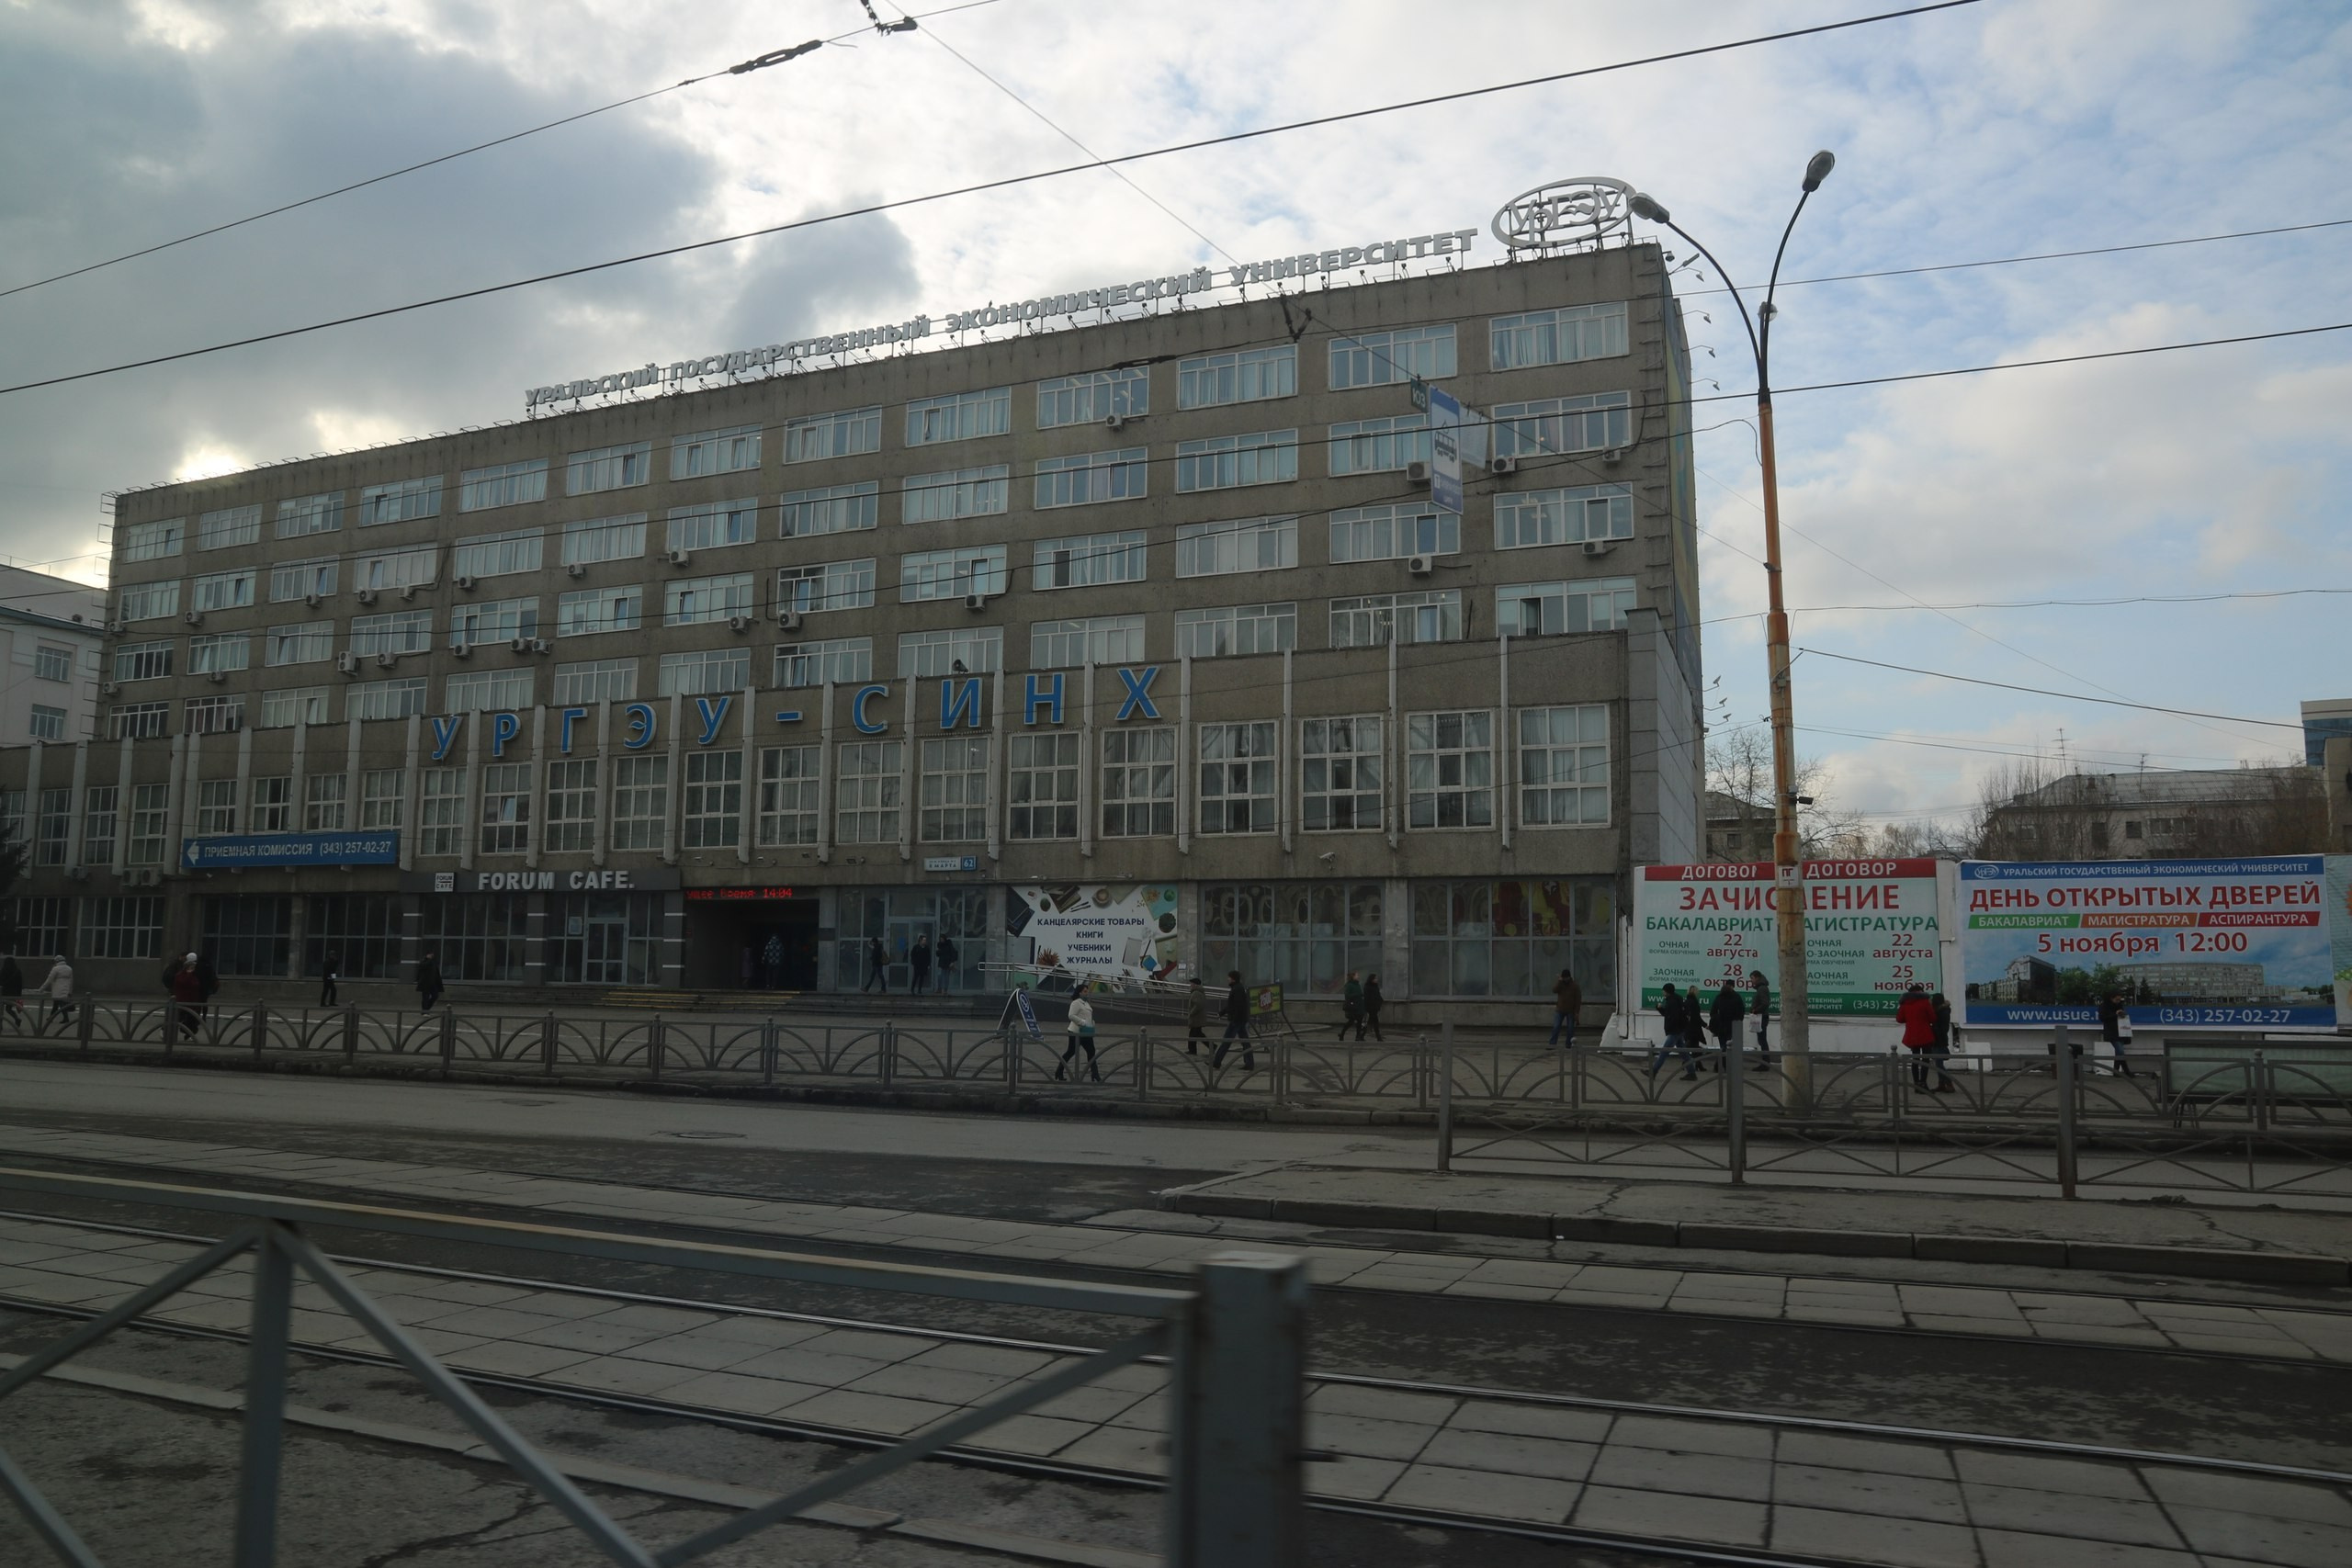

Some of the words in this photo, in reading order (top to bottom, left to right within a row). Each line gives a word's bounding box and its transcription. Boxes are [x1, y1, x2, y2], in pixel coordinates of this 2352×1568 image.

[525, 363, 660, 407] УРАЛЬСКИЙ
[670, 314, 931, 380] ГОСУДАРСТВЕННЫЙ
[945, 266, 1212, 333] ЭКОНОМИЧЕСКИЙ
[1228, 228, 1478, 287] УНИВЕРСИТЕТ
[432, 695, 732, 761] УРГЭУ
[853, 667, 1161, 734] СИНХ
[204, 844, 255, 858] ПРИЕМНАЯ
[257, 843, 312, 856] КОМИССИЯ
[320, 842, 343, 856] (343)
[345, 840, 391, 853] 257-02-27
[963, 859, 974, 868] 62
[2003, 866, 2057, 876] УРАЛЬСКИЙ
[2060, 864, 2151, 875] ГОСУДАРСТВЕННЫЙ
[2154, 863, 2238, 874] ЭКОНОМИЧЕСКИЙ
[2242, 863, 2309, 873] УНИВЕРСИТЕТ
[1806, 862, 1897, 879] ДОГОВОР
[478, 872, 556, 890] FORUM
[763, 887, 793, 898] 14:04
[1679, 885, 1900, 911] ЗАЧИСЕНИЕ
[1970, 888, 2040, 911] ДЕНЬ
[2047, 886, 2201, 907] ОТКРЫТЫХ
[2209, 881, 2321, 909] ДВЕРЕЙ
[1646, 917, 1773, 931] БАКАЛАВРИАТ
[1804, 916, 1939, 931] АГИСТРАТУРА
[1978, 916, 2069, 927] БАКАЛАВРИАТ
[2087, 915, 2189, 926] МАГИСТРАТУРА
[2209, 913, 2309, 925] АСПИРАНТУРА
[1724, 933, 1742, 946] 22
[1892, 933, 1913, 946] 22
[2038, 933, 2052, 953] 5
[2060, 931, 2159, 957] ноября
[2176, 932, 2247, 952] 12:00
[1707, 948, 1758, 960] августа
[1872, 949, 1933, 961] августа
[1654, 968, 1694, 976] ЗАОЧНАЯ
[1724, 964, 1742, 976] 28
[1892, 965, 1913, 978] 25
[1704, 977, 1754, 990] октбр
[1852, 999, 1880, 1010] (343)
[2007, 1009, 2100, 1021] www.usue.r
[2159, 1009, 2199, 1023] (343)
[2203, 1010, 2290, 1022] 257-02-27
